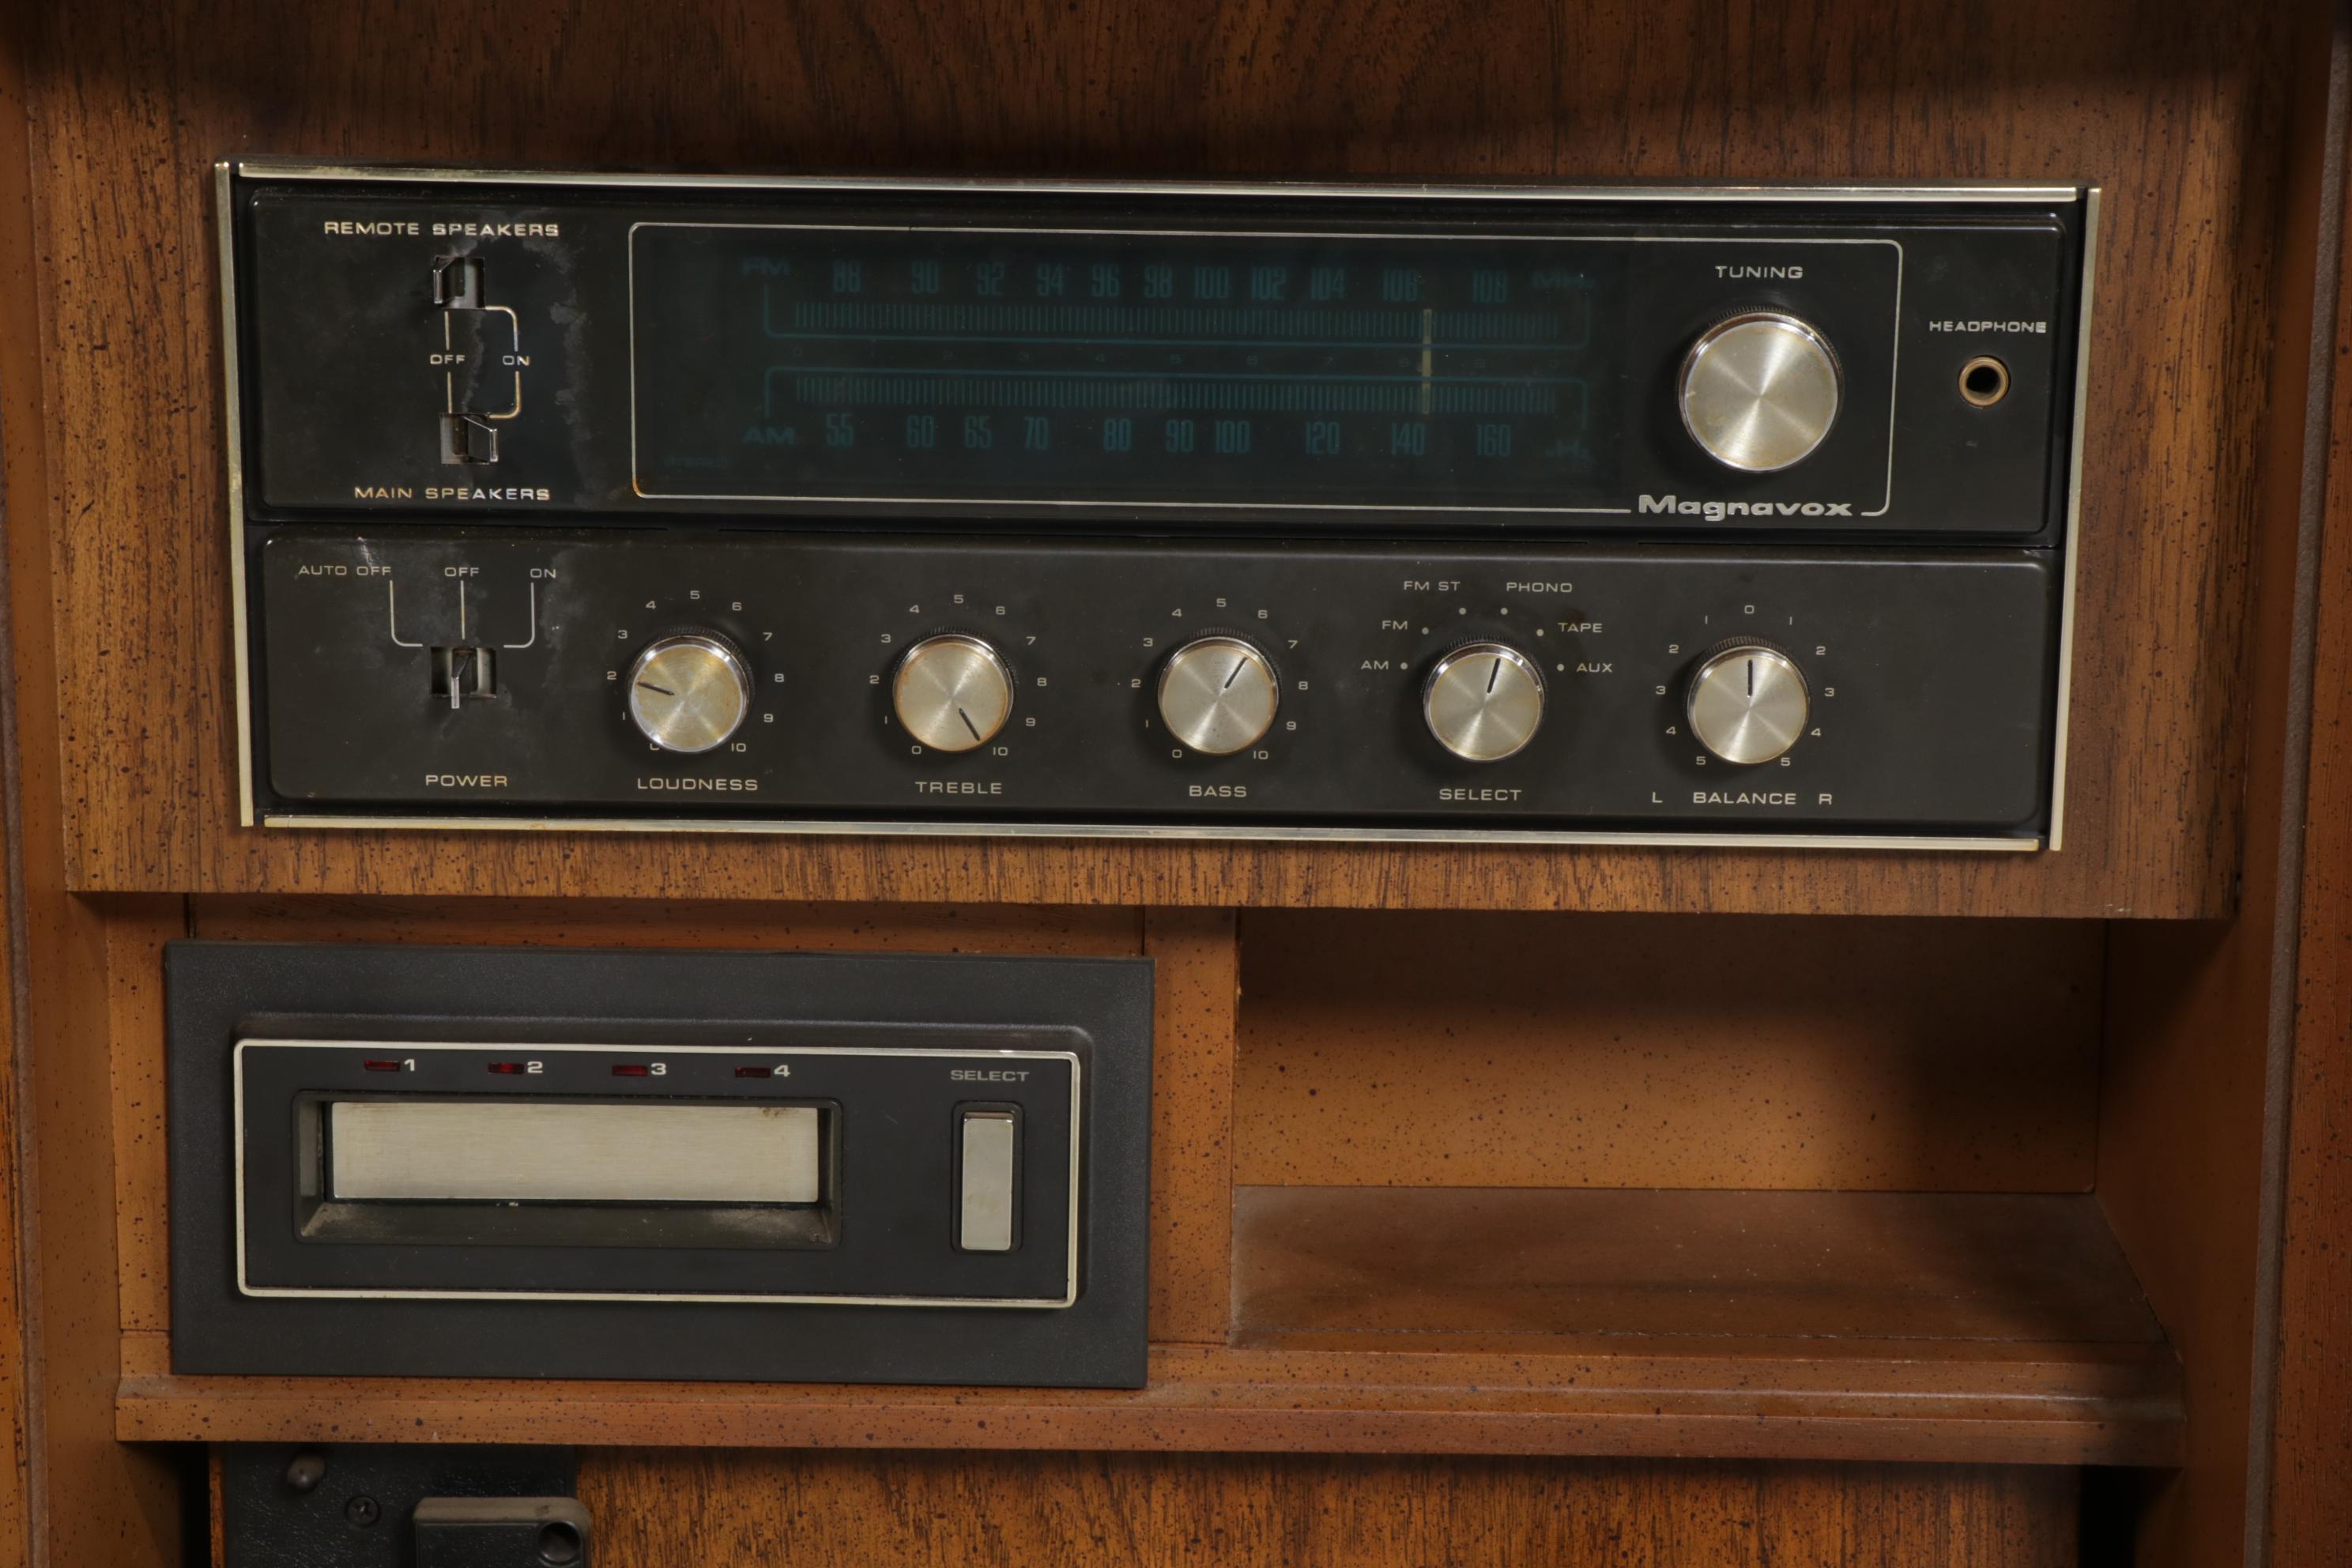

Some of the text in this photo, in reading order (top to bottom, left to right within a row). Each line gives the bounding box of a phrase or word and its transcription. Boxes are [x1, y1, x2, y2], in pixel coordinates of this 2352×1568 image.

[325, 222, 558, 236] REMOTE SPEAKERS
[1716, 266, 1803, 278] TUNING
[742, 258, 789, 276] FM
[912, 260, 939, 293] 90
[977, 262, 1004, 296] 92
[1037, 264, 1064, 296] 94
[1092, 264, 1119, 297] 96
[1194, 266, 1229, 299] 100
[1252, 267, 1287, 300] 102
[1310, 267, 1345, 300] 104
[1930, 321, 2046, 333] HEADPHONE
[430, 354, 465, 364] OFF
[503, 356, 529, 365] ON
[742, 427, 795, 443] AM
[827, 413, 854, 447] 55
[907, 416, 935, 447] 60
[965, 416, 992, 448] 65
[1024, 417, 1050, 450] 70
[1103, 418, 1131, 451] 80
[1165, 420, 1194, 452] 90
[1215, 420, 1250, 453] 100
[1306, 422, 1340, 455] 120
[1392, 423, 1426, 455] 140
[1477, 424, 1510, 457] 160
[355, 487, 549, 500] MAIN SPEAKERS
[1639, 495, 1853, 521] Magnavox
[299, 566, 390, 575] AUTO OFF
[445, 567, 479, 576] OFF
[530, 568, 556, 579] ON
[1404, 581, 1461, 590] FM ST
[1506, 582, 1572, 592] PHONO
[690, 590, 699, 599] 5
[954, 594, 963, 603] 5
[733, 602, 741, 611] 6
[1216, 598, 1226, 607] 5
[910, 605, 919, 613] 4
[996, 606, 1005, 615] 6
[1744, 605, 1755, 614] 0
[1382, 620, 1408, 629] FM
[1559, 623, 1602, 632] TAPE
[618, 630, 628, 639] 3
[881, 634, 891, 643] 3
[1027, 636, 1035, 645] 7
[1144, 638, 1153, 646] 3
[1816, 646, 1826, 655] 2
[1361, 661, 1389, 669] AM
[1577, 663, 1612, 673] AUX
[607, 671, 616, 680] 2
[775, 673, 784, 682] 8
[870, 675, 879, 684] 2
[1038, 677, 1046, 686] 8
[1132, 679, 1140, 688] 2
[1298, 681, 1308, 690] 8
[1656, 686, 1665, 695] 3
[1825, 688, 1834, 696] 3
[764, 714, 773, 722] 9
[1026, 718, 1035, 726] 9
[1287, 722, 1296, 730] 9
[732, 743, 746, 752] 10
[993, 747, 1008, 756] 10
[1172, 749, 1182, 758] 0
[1253, 751, 1268, 760] 10
[1696, 756, 1706, 765] 5
[1781, 756, 1790, 766] 5
[426, 775, 507, 786] POWER
[638, 778, 757, 790] LOUDNESS
[915, 782, 1001, 793] TREBLE
[1189, 786, 1246, 797] BASS
[1440, 789, 1521, 801] SELECT
[1653, 792, 1832, 805] L BALANCE R
[405, 1059, 414, 1071] 1
[528, 1061, 542, 1073] 2
[651, 1063, 666, 1075] 3
[775, 1065, 790, 1076] 4
[951, 1070, 1029, 1081] SELECT
